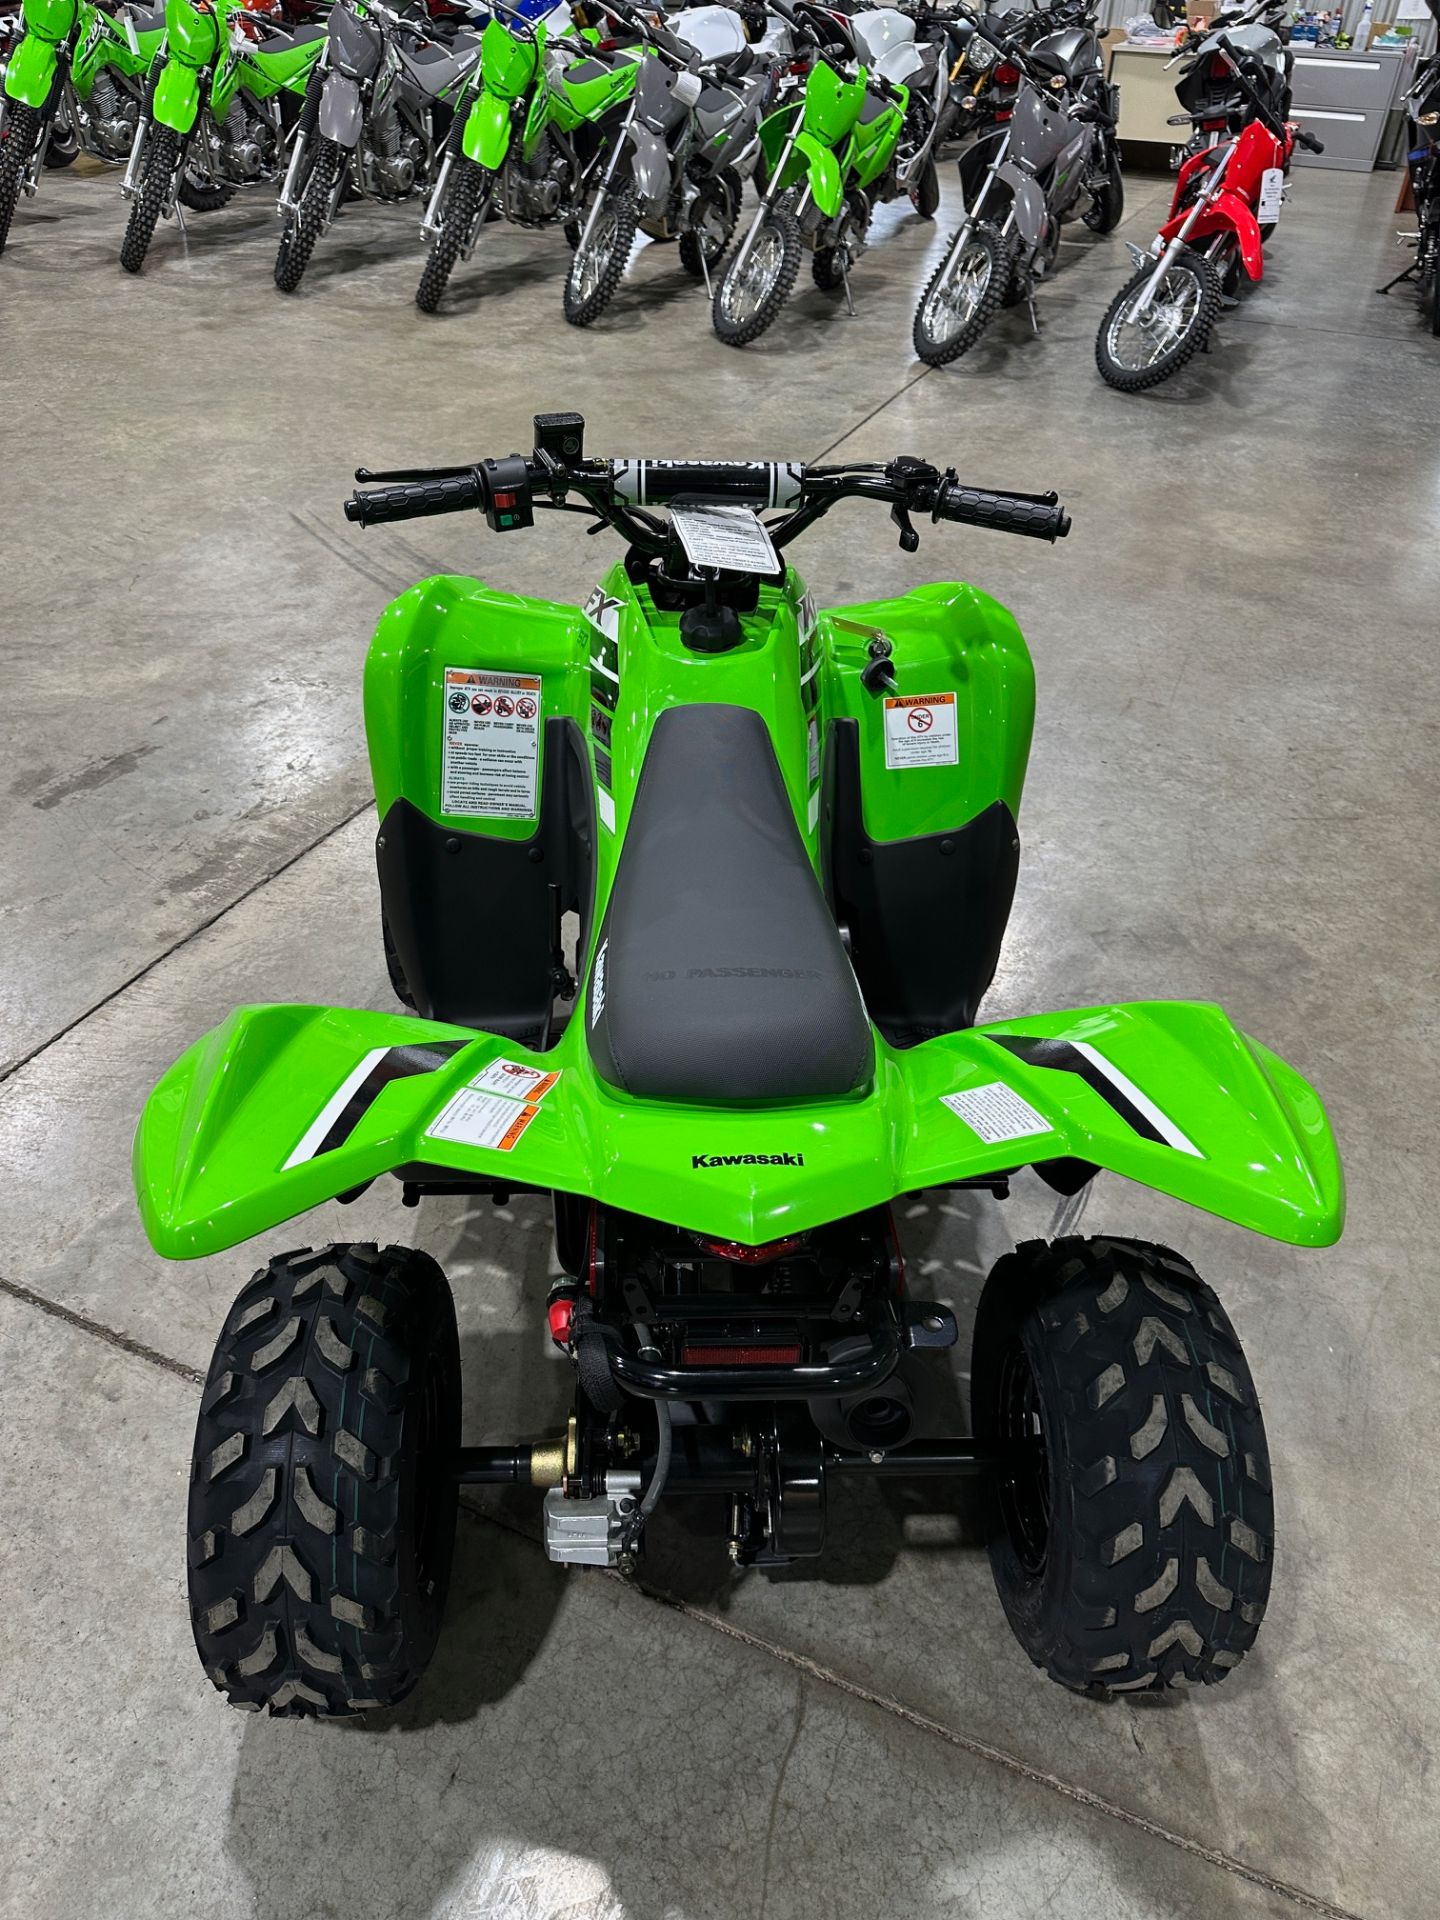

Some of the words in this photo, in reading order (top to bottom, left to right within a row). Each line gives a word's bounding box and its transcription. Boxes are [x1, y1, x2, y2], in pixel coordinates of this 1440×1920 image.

[479, 676, 521, 687] WARNING
[905, 696, 945, 705] WARNING
[692, 1152, 804, 1169] Kawasaki
